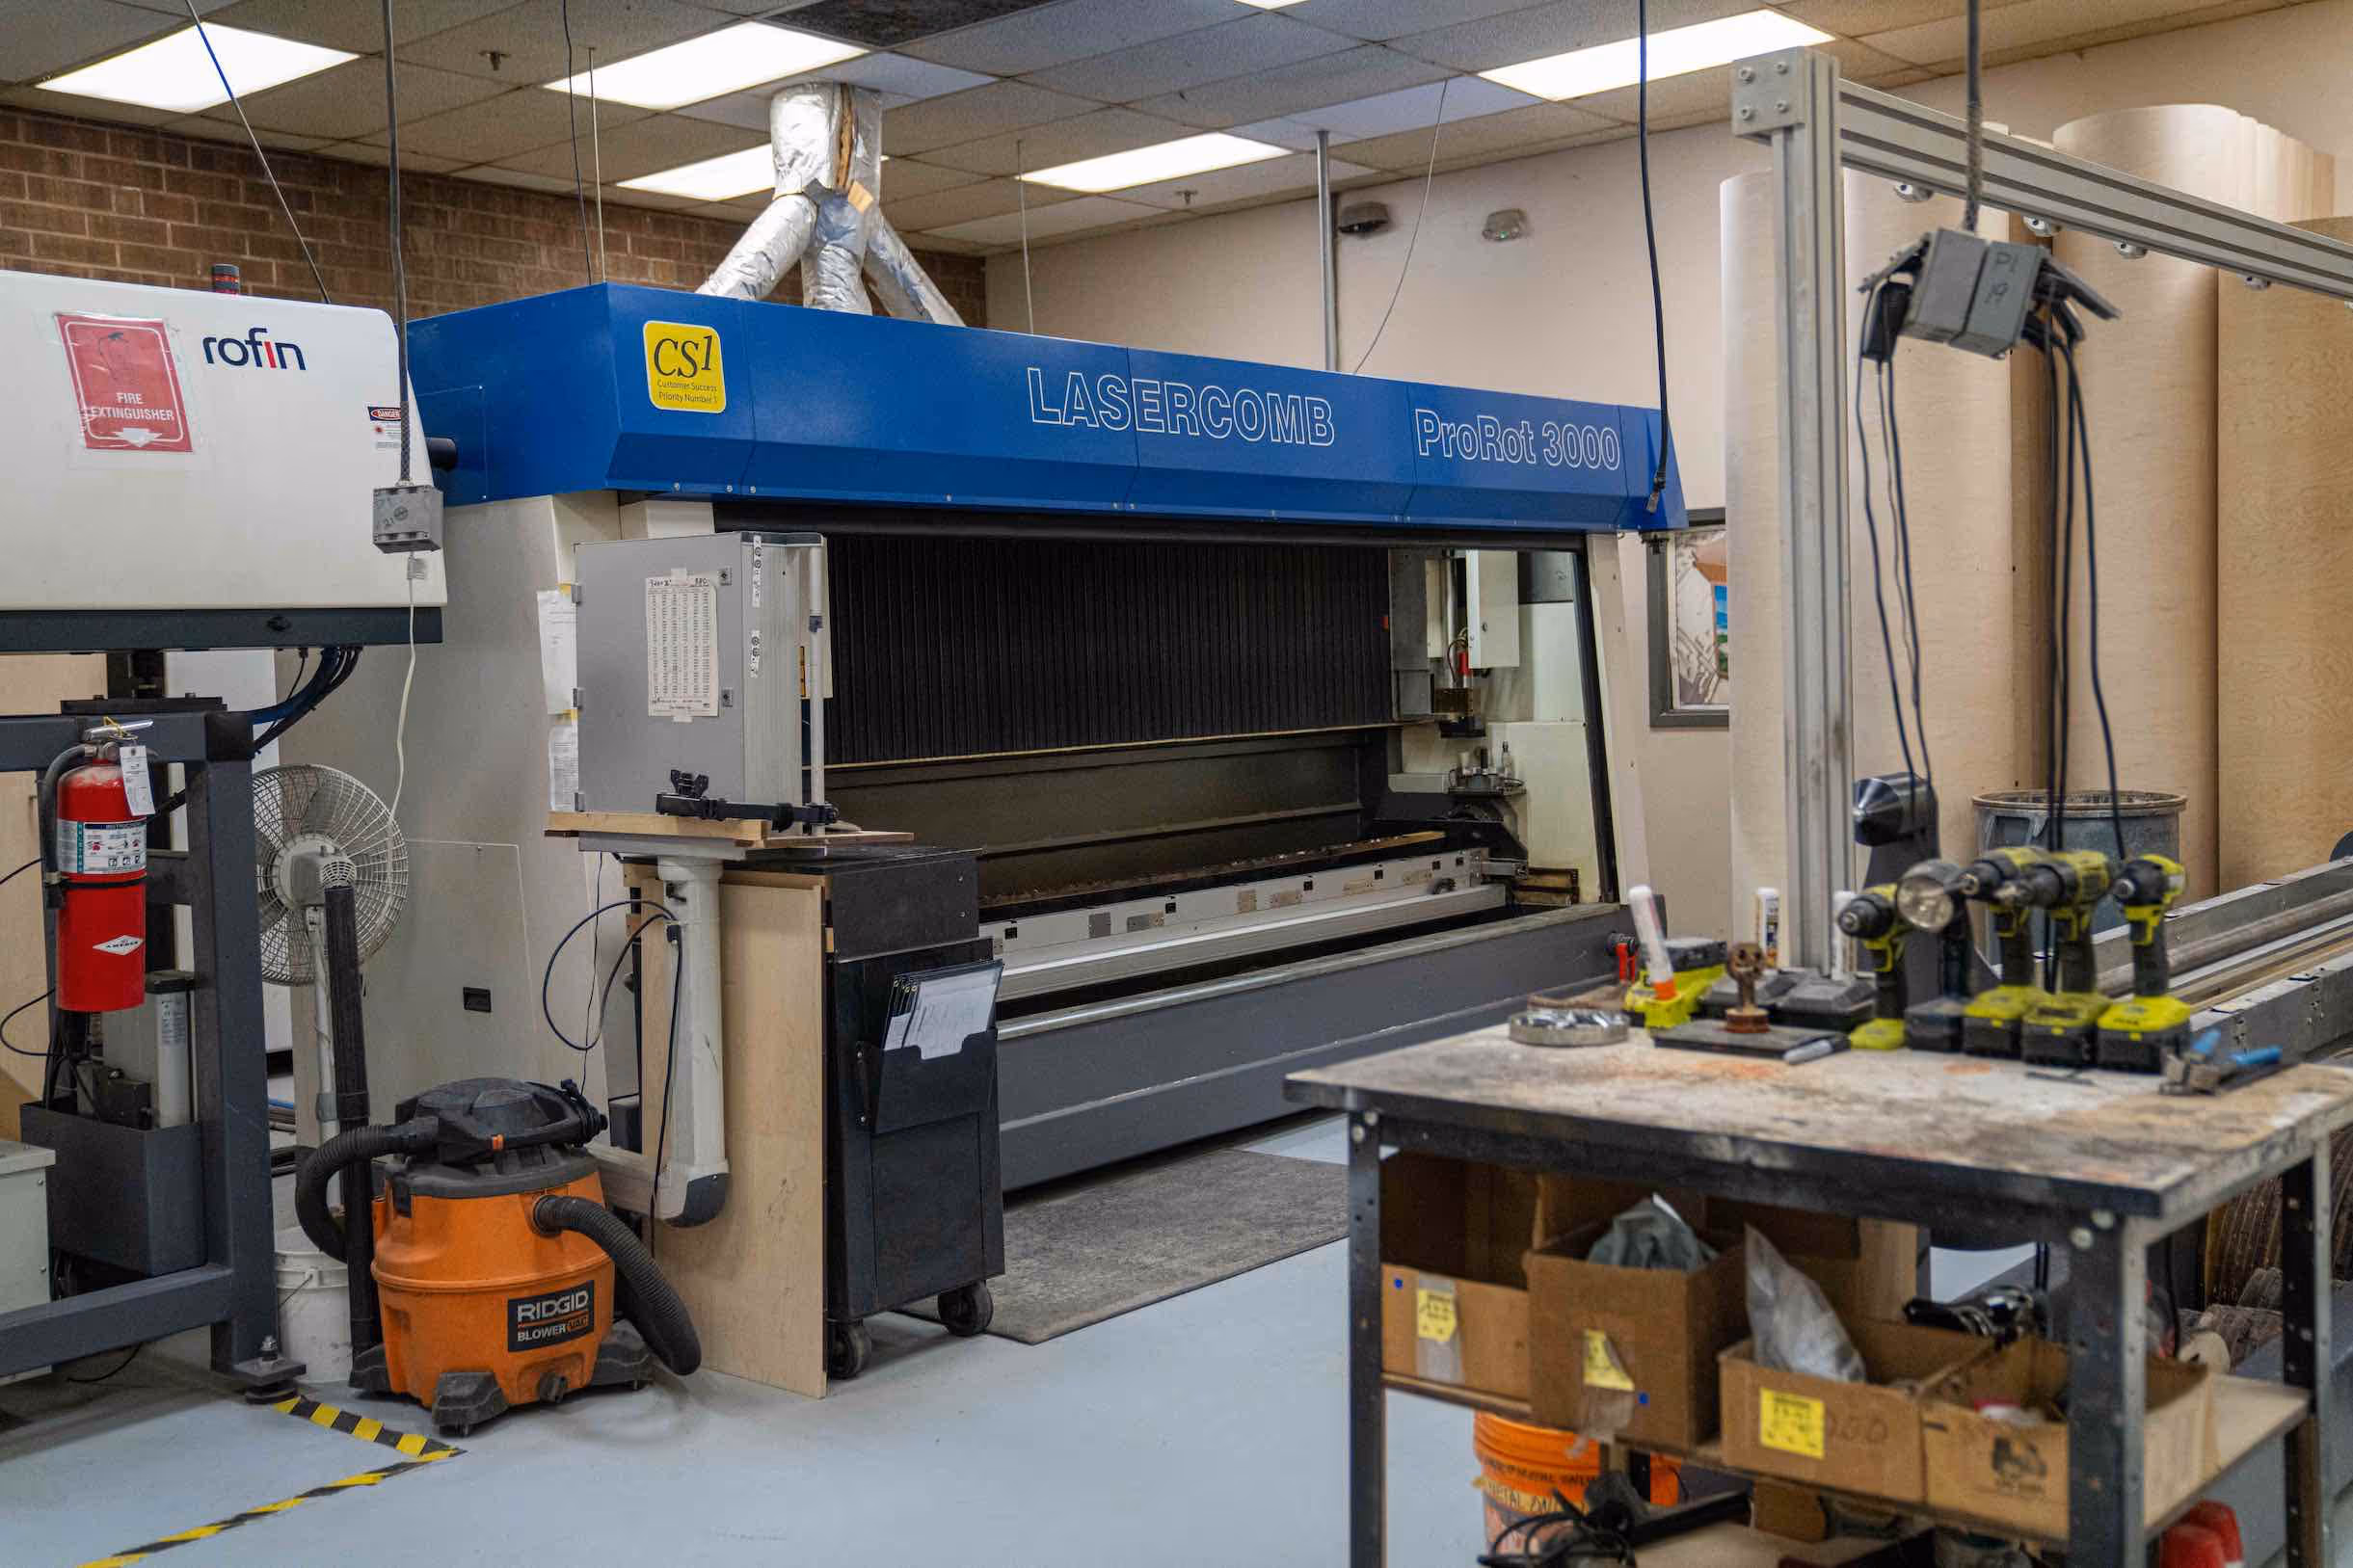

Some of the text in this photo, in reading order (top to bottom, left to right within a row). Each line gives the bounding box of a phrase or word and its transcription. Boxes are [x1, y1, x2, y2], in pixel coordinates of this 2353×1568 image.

[202, 327, 307, 371] rofin
[691, 383, 717, 392] Success
[116, 392, 144, 405] FIRE
[658, 391, 683, 403] Priority
[684, 393, 711, 404] Number
[1027, 366, 1335, 446] LASERCOMB
[91, 407, 175, 421] EXTINGUISHER
[1415, 408, 1620, 471] ProRot 3000
[517, 1290, 589, 1322] RIDGID
[517, 1323, 567, 1342] BLOWER
